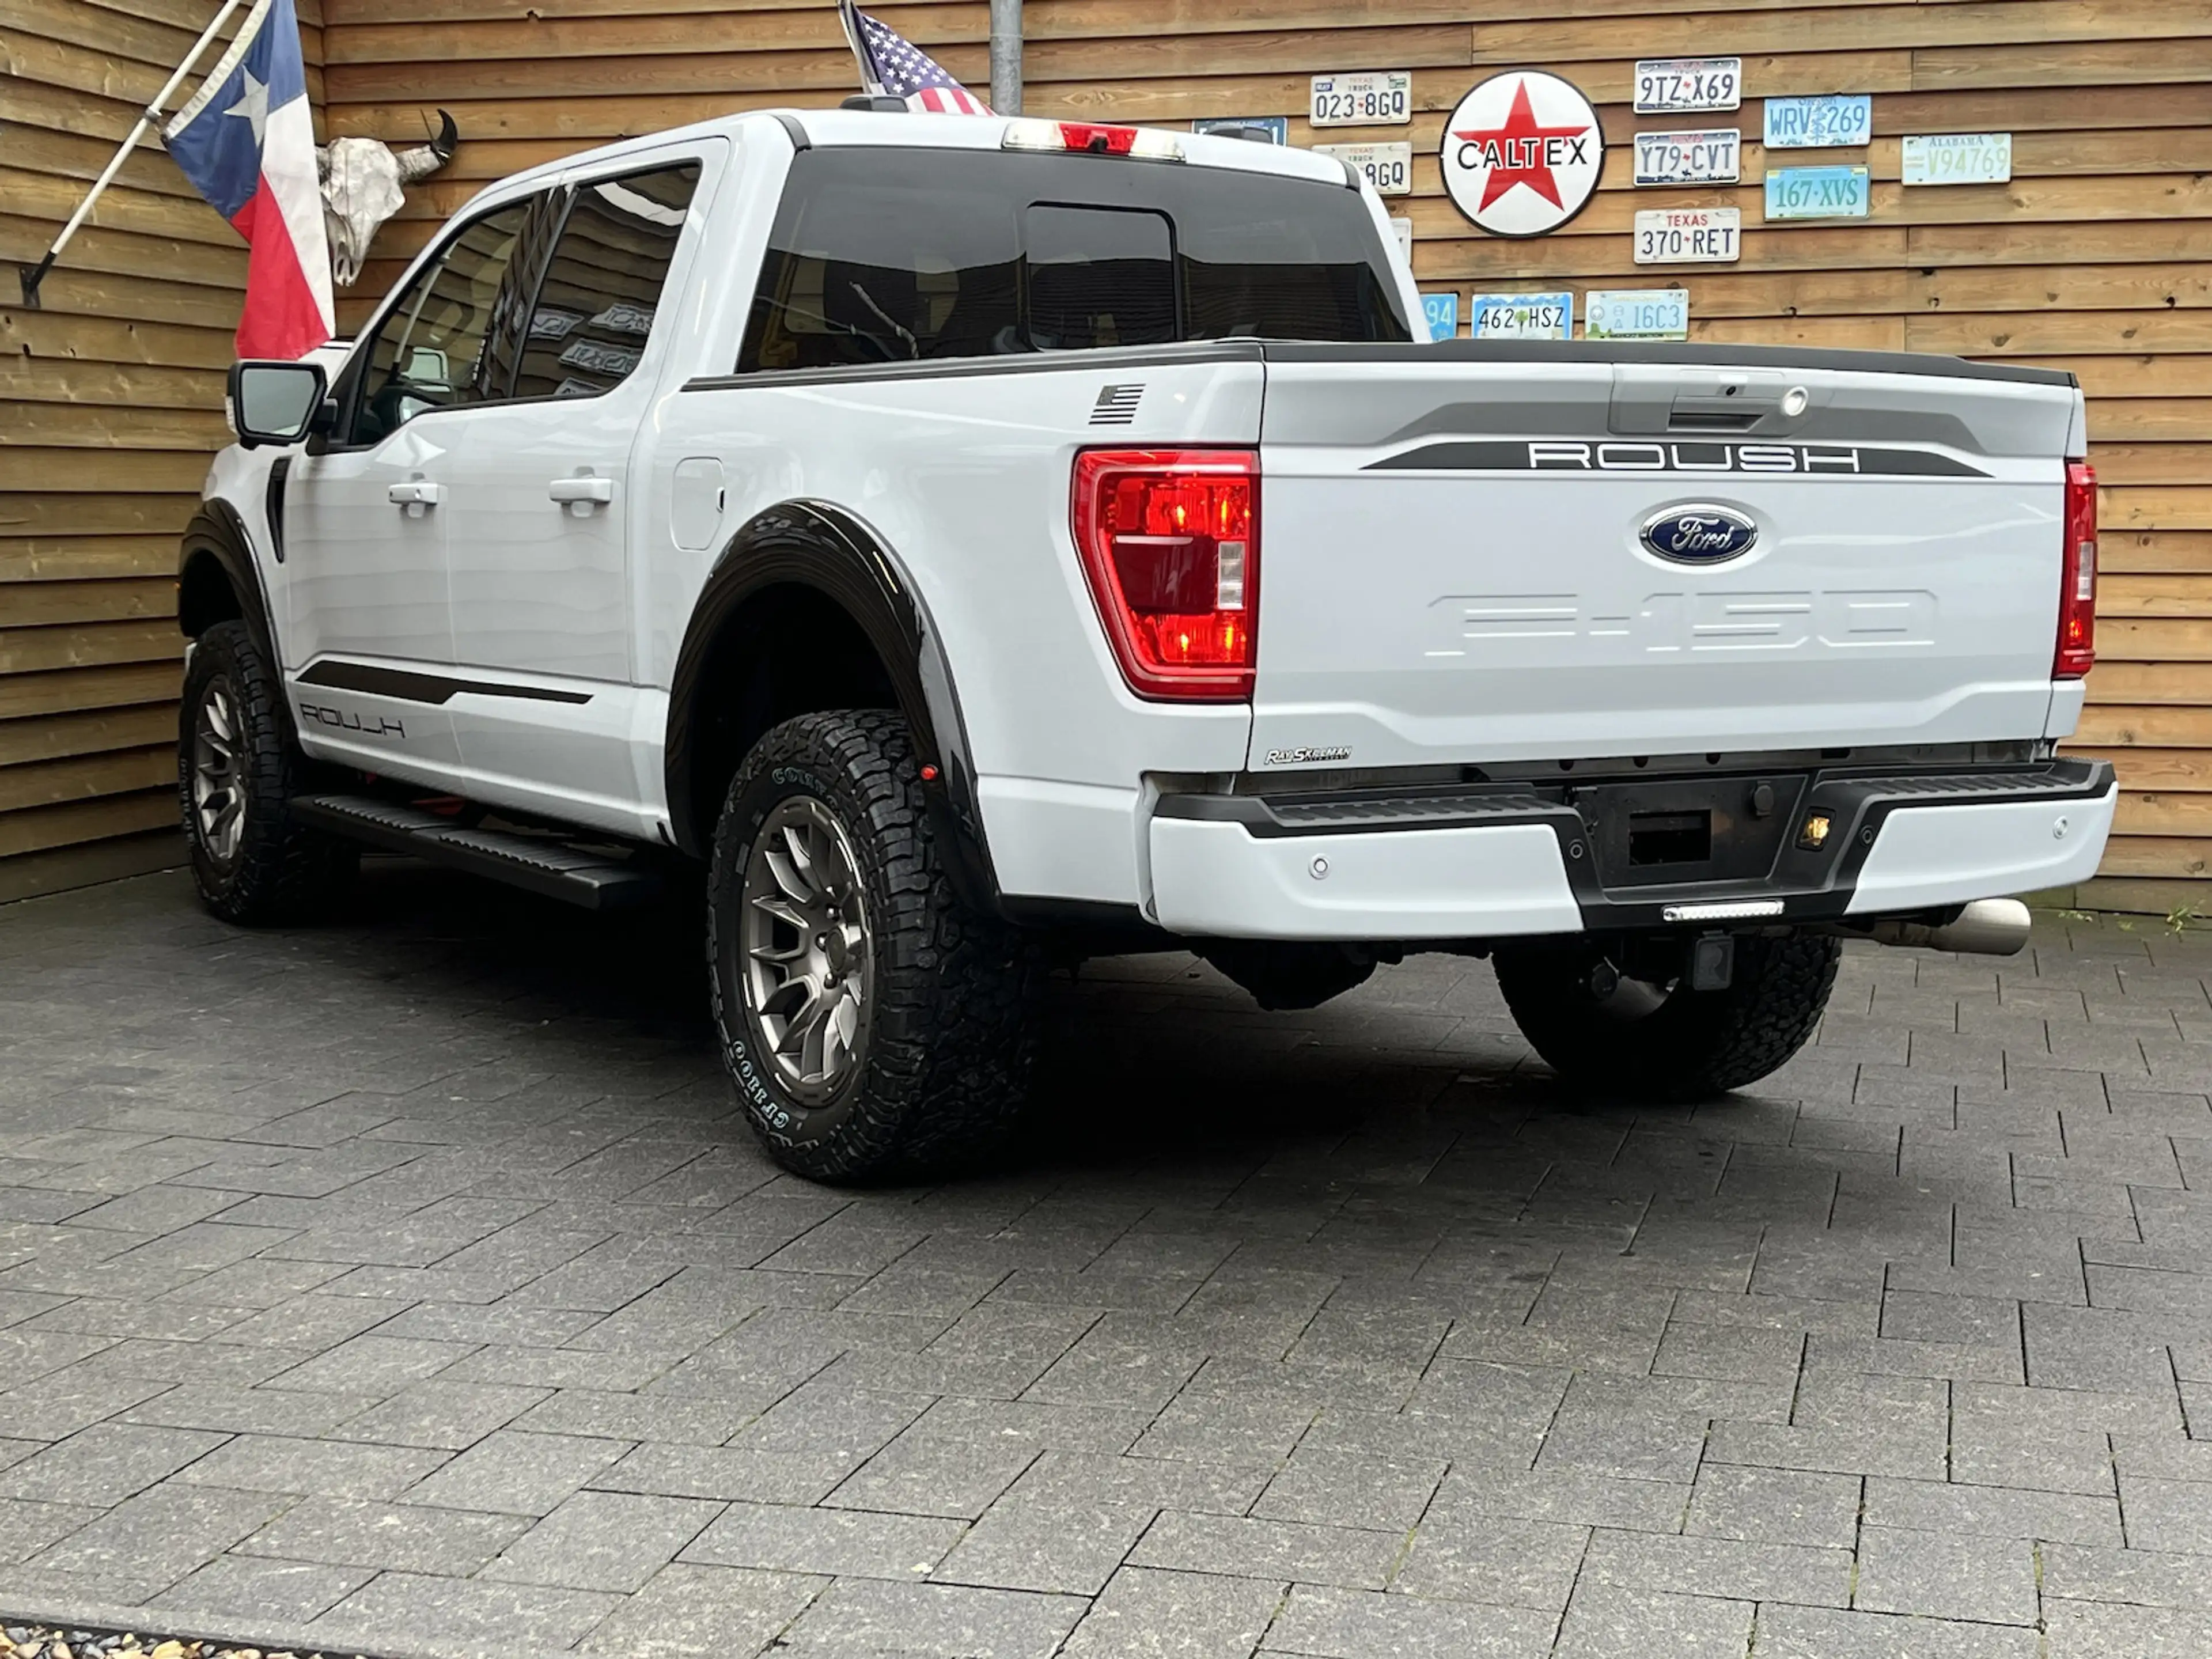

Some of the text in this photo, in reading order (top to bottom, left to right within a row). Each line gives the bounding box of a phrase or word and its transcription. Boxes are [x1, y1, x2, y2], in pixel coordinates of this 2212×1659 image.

[1770, 105, 1866, 136] WRV 269
[1457, 138, 1588, 170] CALTEX
[1929, 135, 1984, 147] ALABAMA
[1666, 214, 1709, 228] TEXAS
[1478, 306, 1565, 329] 462 HSZ
[1527, 442, 1861, 473] ROUSH
[1671, 516, 1734, 552] Ford
[1424, 590, 1940, 657] F-150
